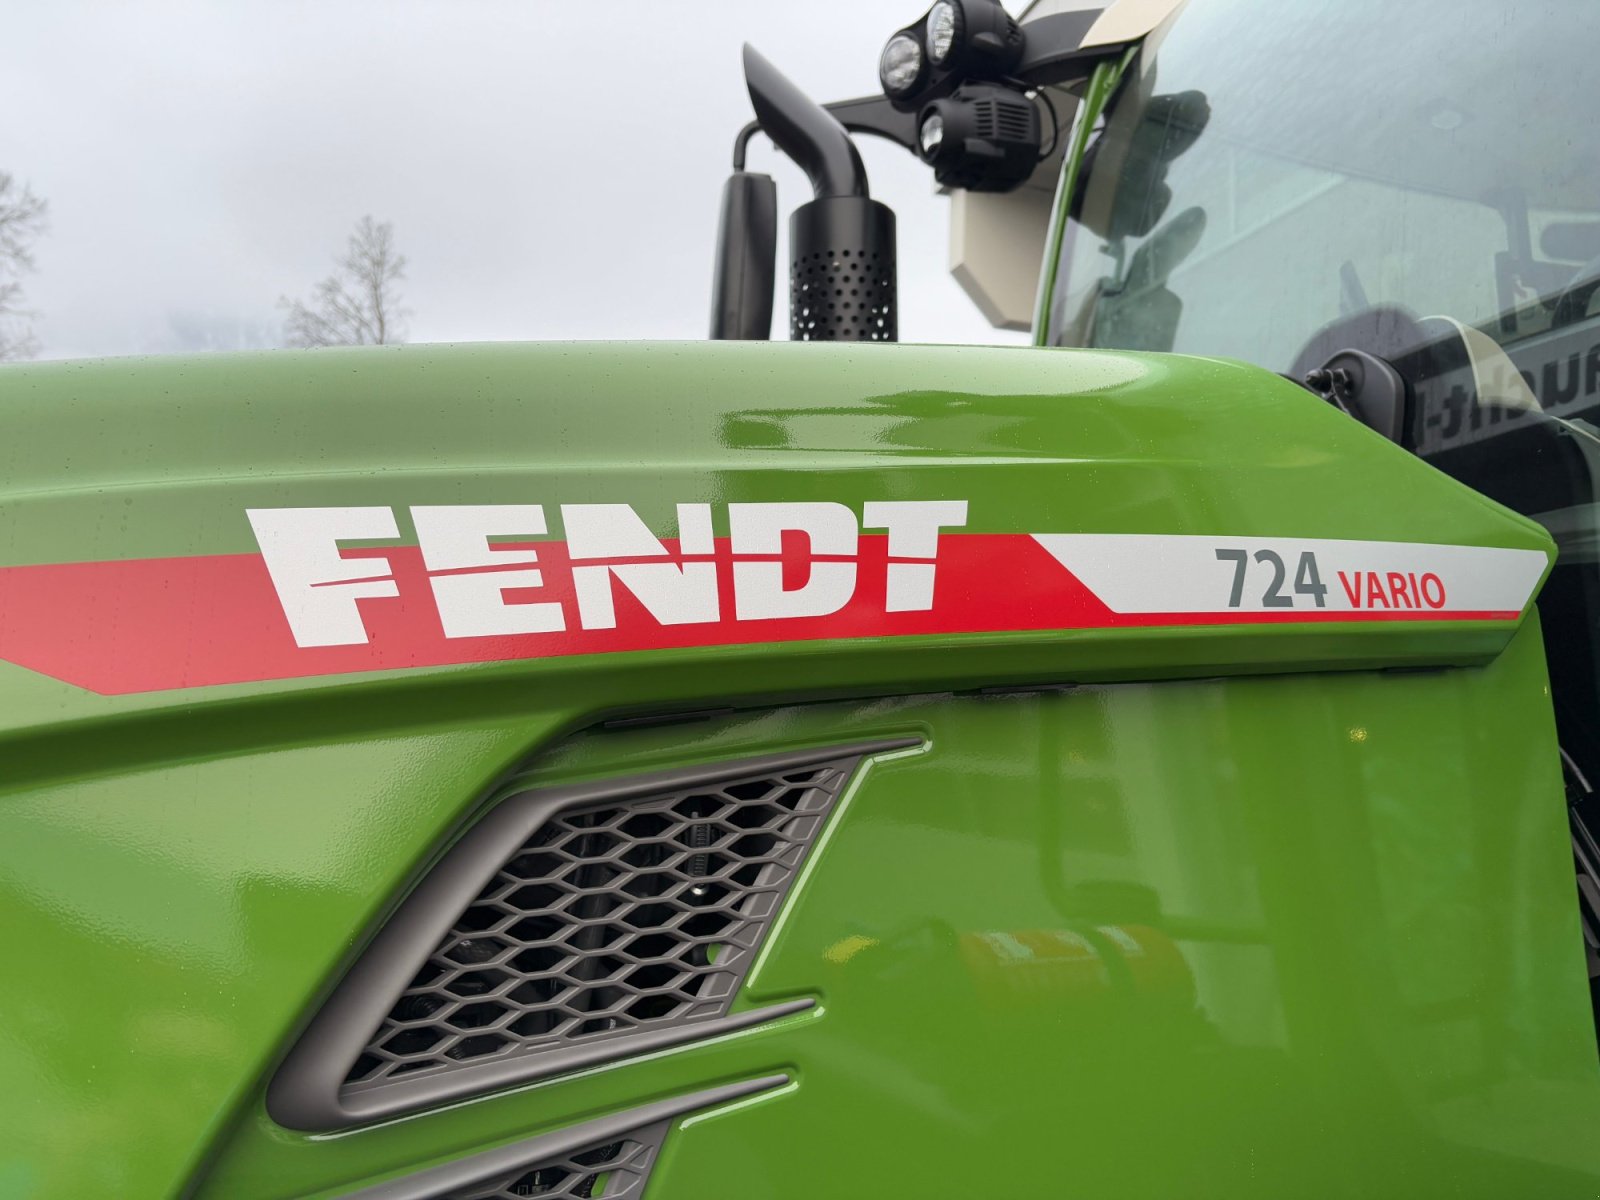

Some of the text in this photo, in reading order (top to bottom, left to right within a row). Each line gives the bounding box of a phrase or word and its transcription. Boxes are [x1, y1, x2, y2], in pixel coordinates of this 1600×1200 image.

[245, 500, 969, 649] FENDT
[1215, 548, 1447, 610] 724 VARIO
